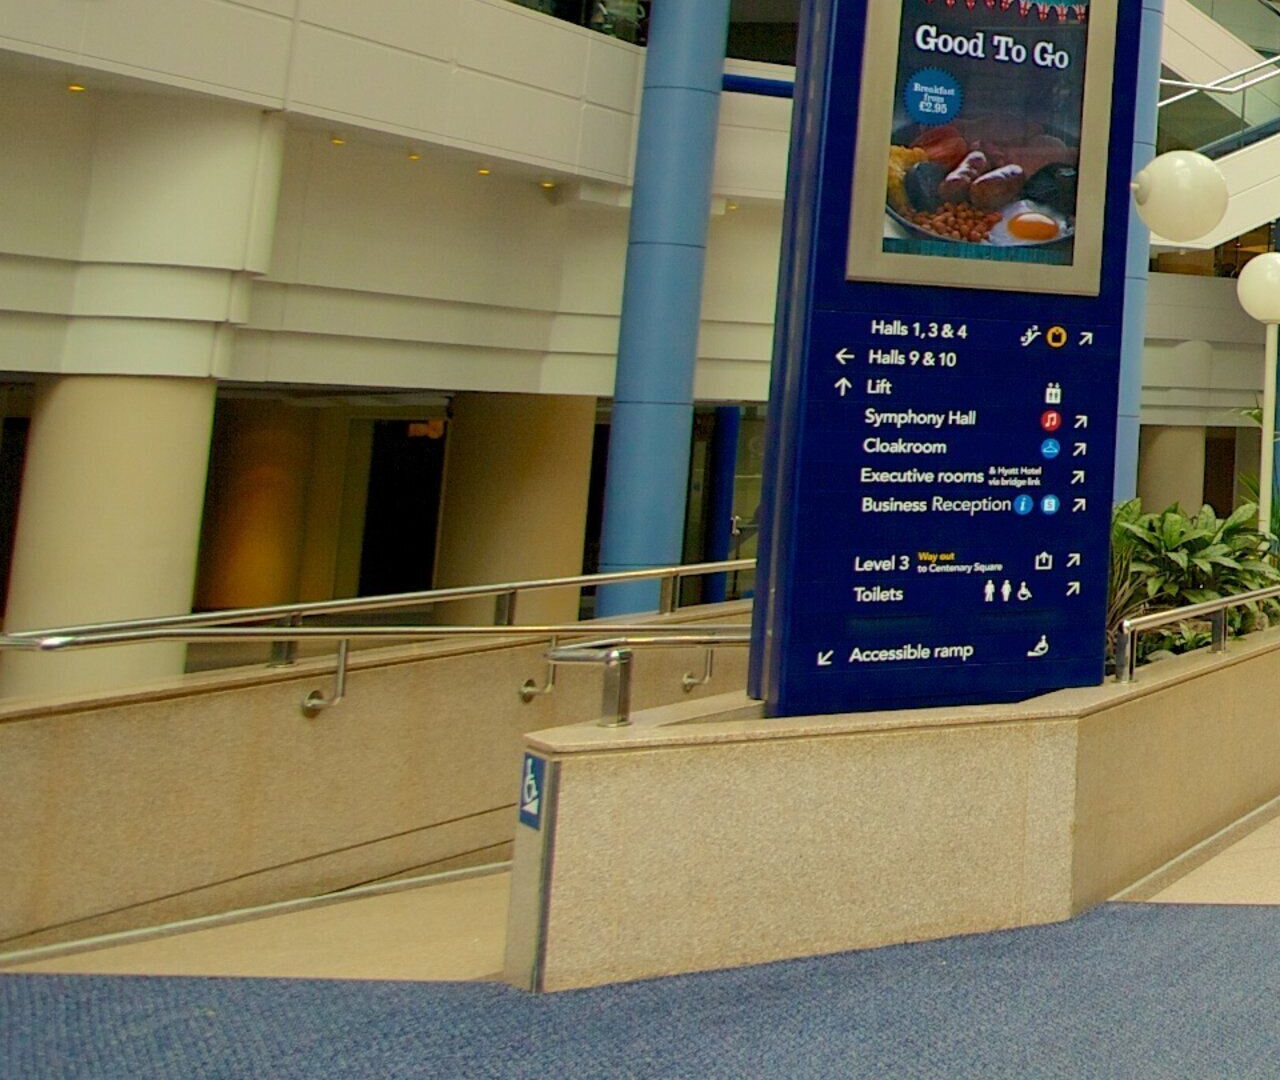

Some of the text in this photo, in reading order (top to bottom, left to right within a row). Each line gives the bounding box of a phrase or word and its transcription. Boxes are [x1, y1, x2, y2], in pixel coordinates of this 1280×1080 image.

[916, 25, 1070, 70] Good To Go
[913, 82, 955, 96] Breakfast
[871, 320, 908, 338] Halls
[928, 323, 938, 338] 3
[941, 324, 954, 338] &
[956, 324, 967, 339] 4
[868, 349, 957, 367] Halls 9 & 10
[866, 378, 892, 395] Lift
[864, 407, 976, 428] Symphony Hall
[863, 438, 947, 455] Cloakroom
[861, 467, 984, 484] Executive rooms
[997, 466, 1018, 477] Hyatt
[1020, 466, 1042, 476] Hotel
[1001, 476, 1026, 488] bridge
[1027, 477, 1041, 486] link
[861, 497, 1012, 517] Business Reception
[854, 555, 910, 572] Level 3
[918, 552, 955, 563] Way out
[917, 562, 1003, 574] to Centenary Square
[854, 585, 904, 602] Toilets
[848, 644, 974, 663] Accessible ramp
